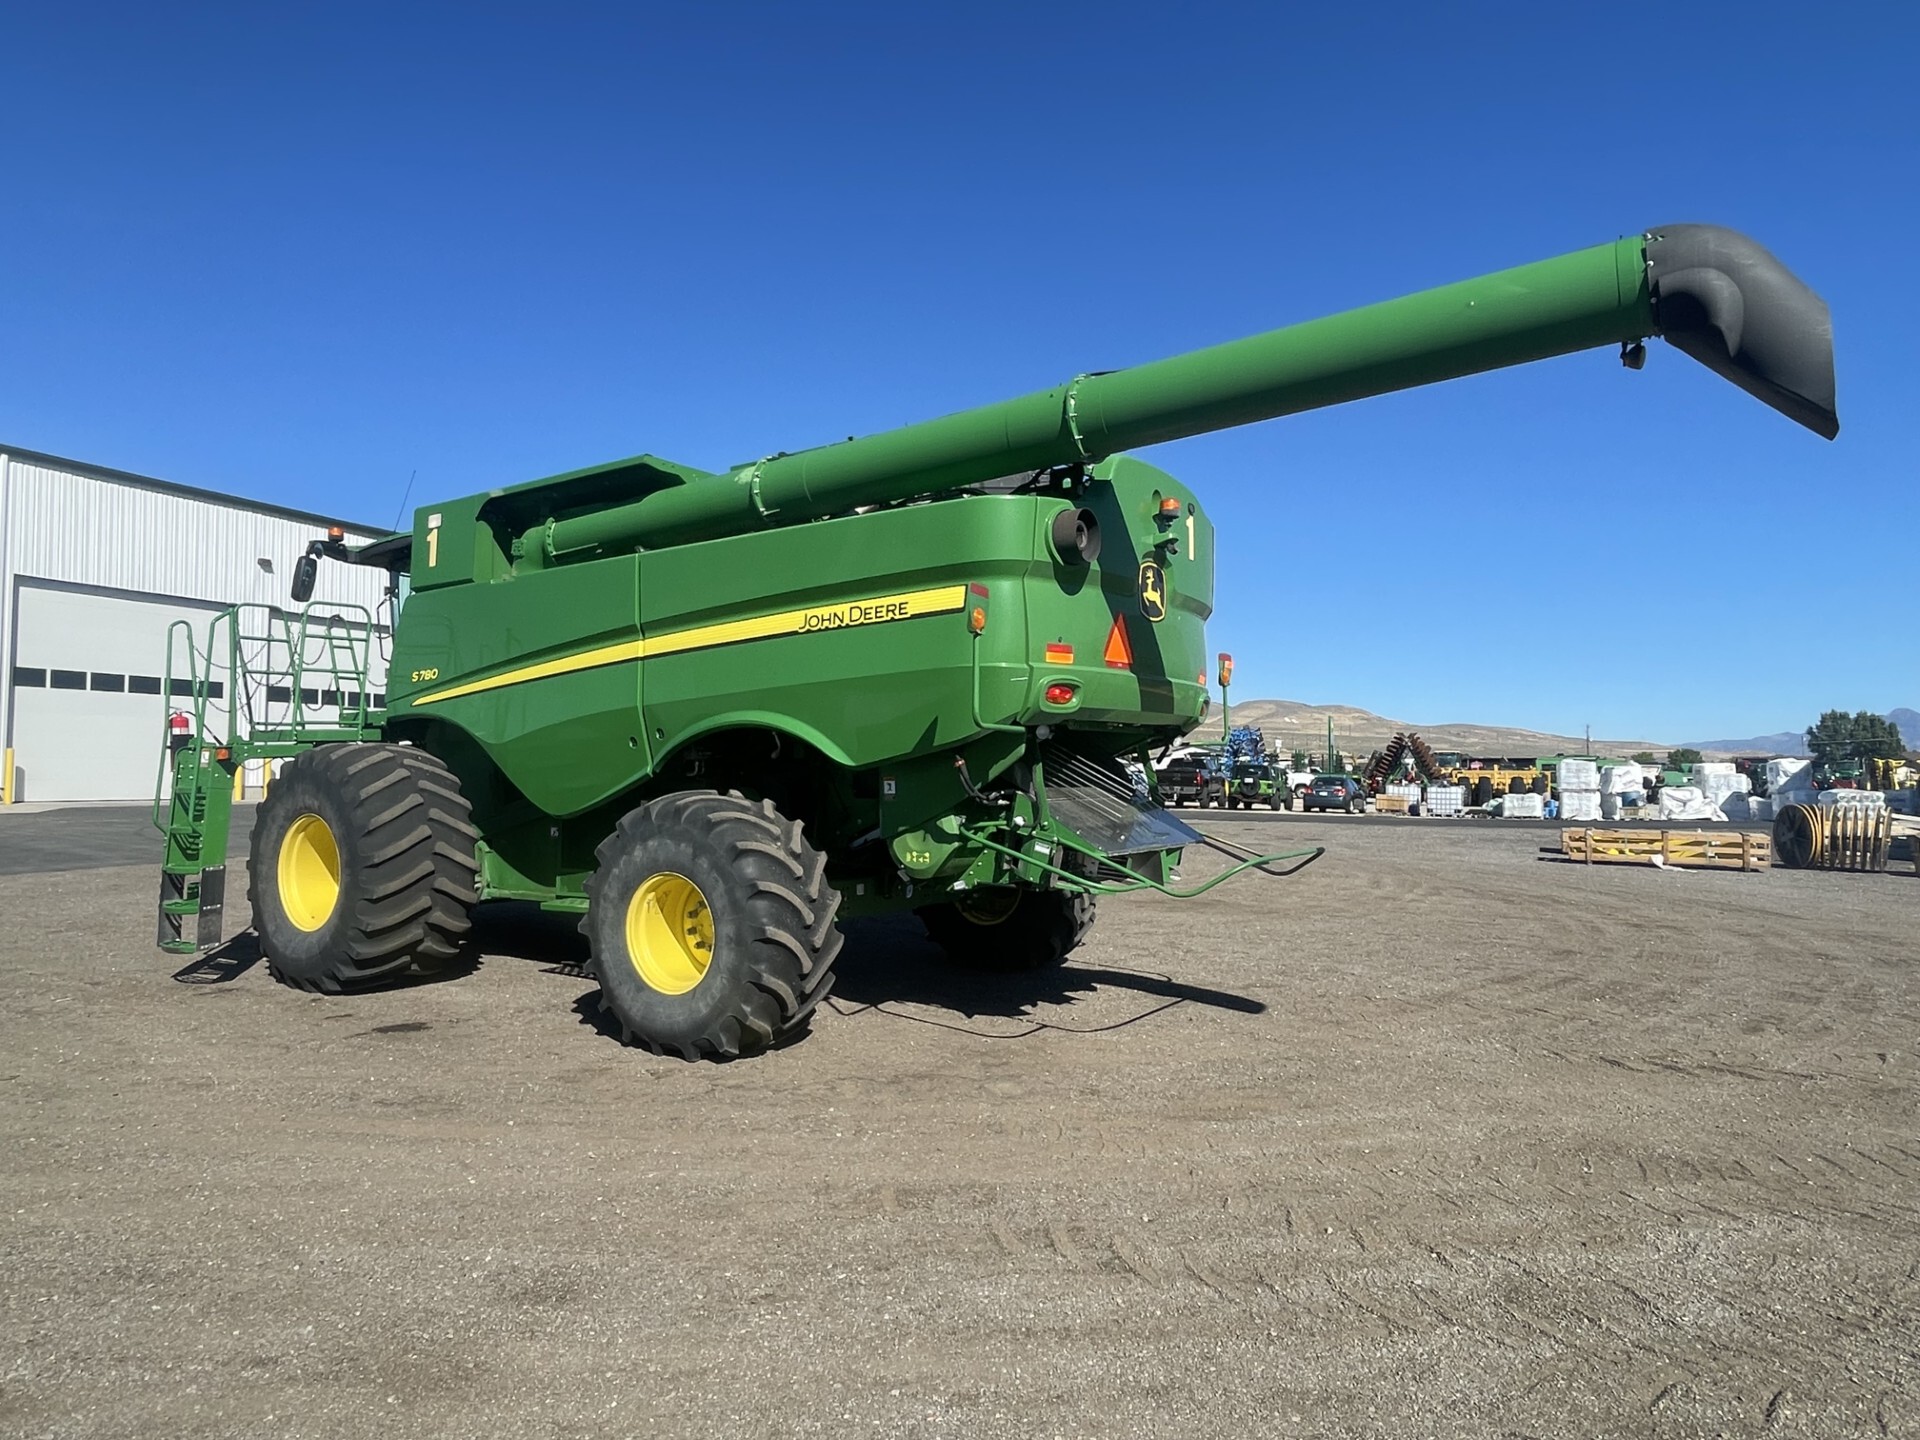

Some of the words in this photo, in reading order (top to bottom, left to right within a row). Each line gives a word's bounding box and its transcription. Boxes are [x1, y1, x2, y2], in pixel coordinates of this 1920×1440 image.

[426, 528, 438, 568] 1
[1185, 515, 1195, 561] 1
[798, 611, 845, 631] JOHN
[849, 601, 910, 623] DEERE
[411, 667, 439, 683] S780
